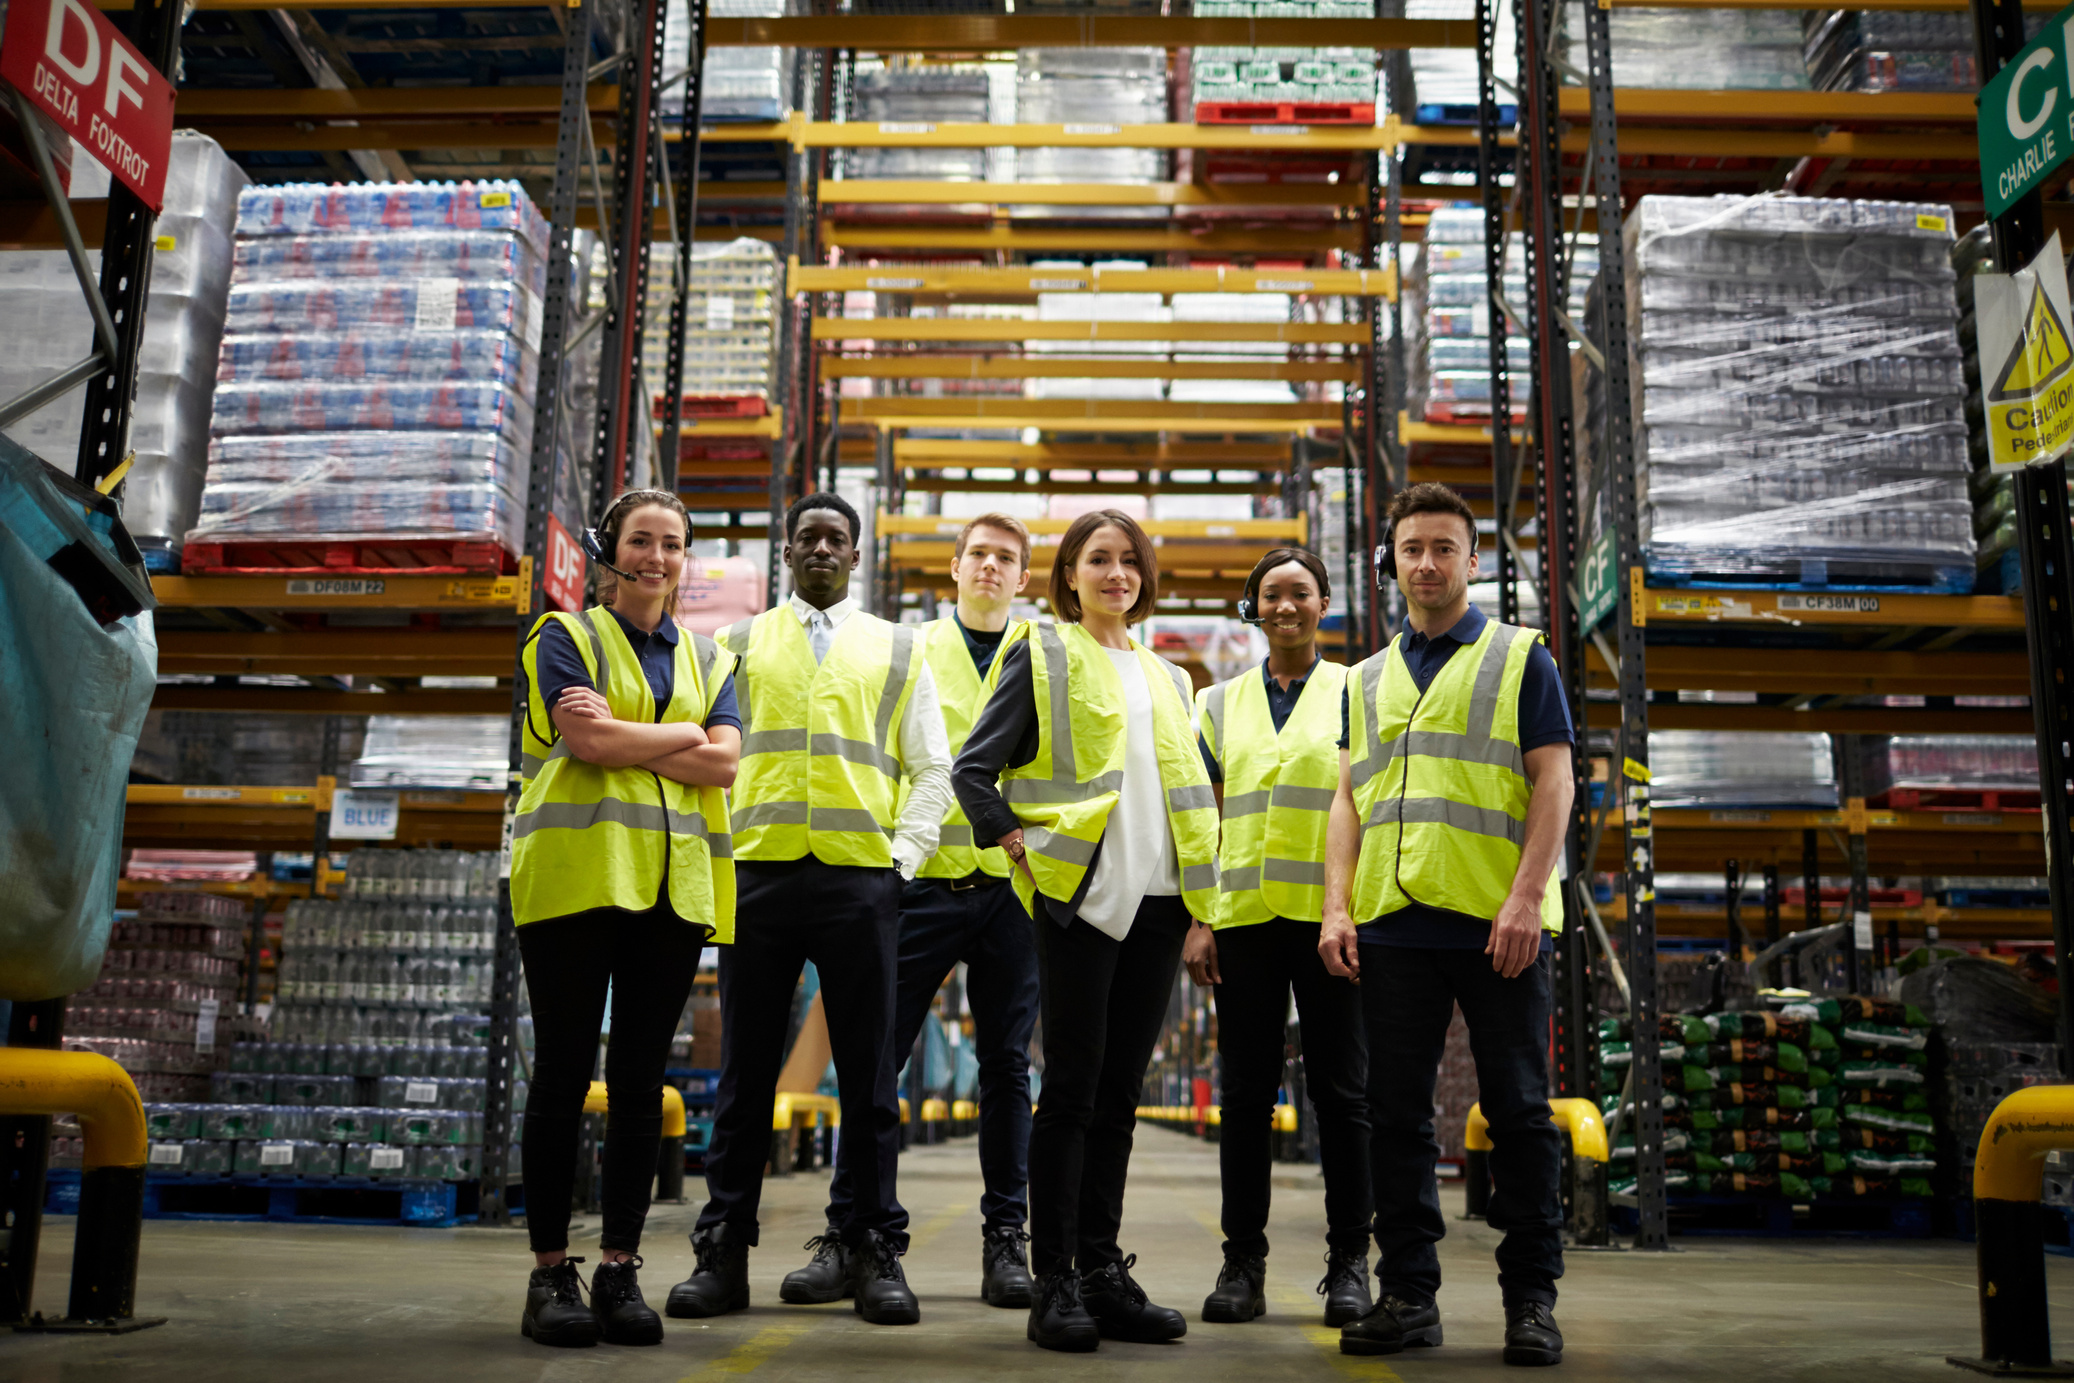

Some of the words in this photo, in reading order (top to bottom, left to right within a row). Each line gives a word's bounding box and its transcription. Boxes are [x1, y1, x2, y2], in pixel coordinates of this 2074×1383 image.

[45, 0, 149, 119] DF
[2005, 15, 2074, 140] C
[33, 61, 79, 126] DELTA
[88, 112, 150, 187] FOXTROT
[1999, 129, 2057, 200] CHARLIE
[2005, 383, 2074, 431] Caution
[313, 581, 362, 594] DF08M
[366, 582, 384, 593] 22
[553, 529, 581, 589] DF
[1584, 538, 1609, 602] CF
[1806, 596, 1856, 610] CF38M
[1861, 597, 1878, 611] 00
[344, 808, 391, 826] BLUE
